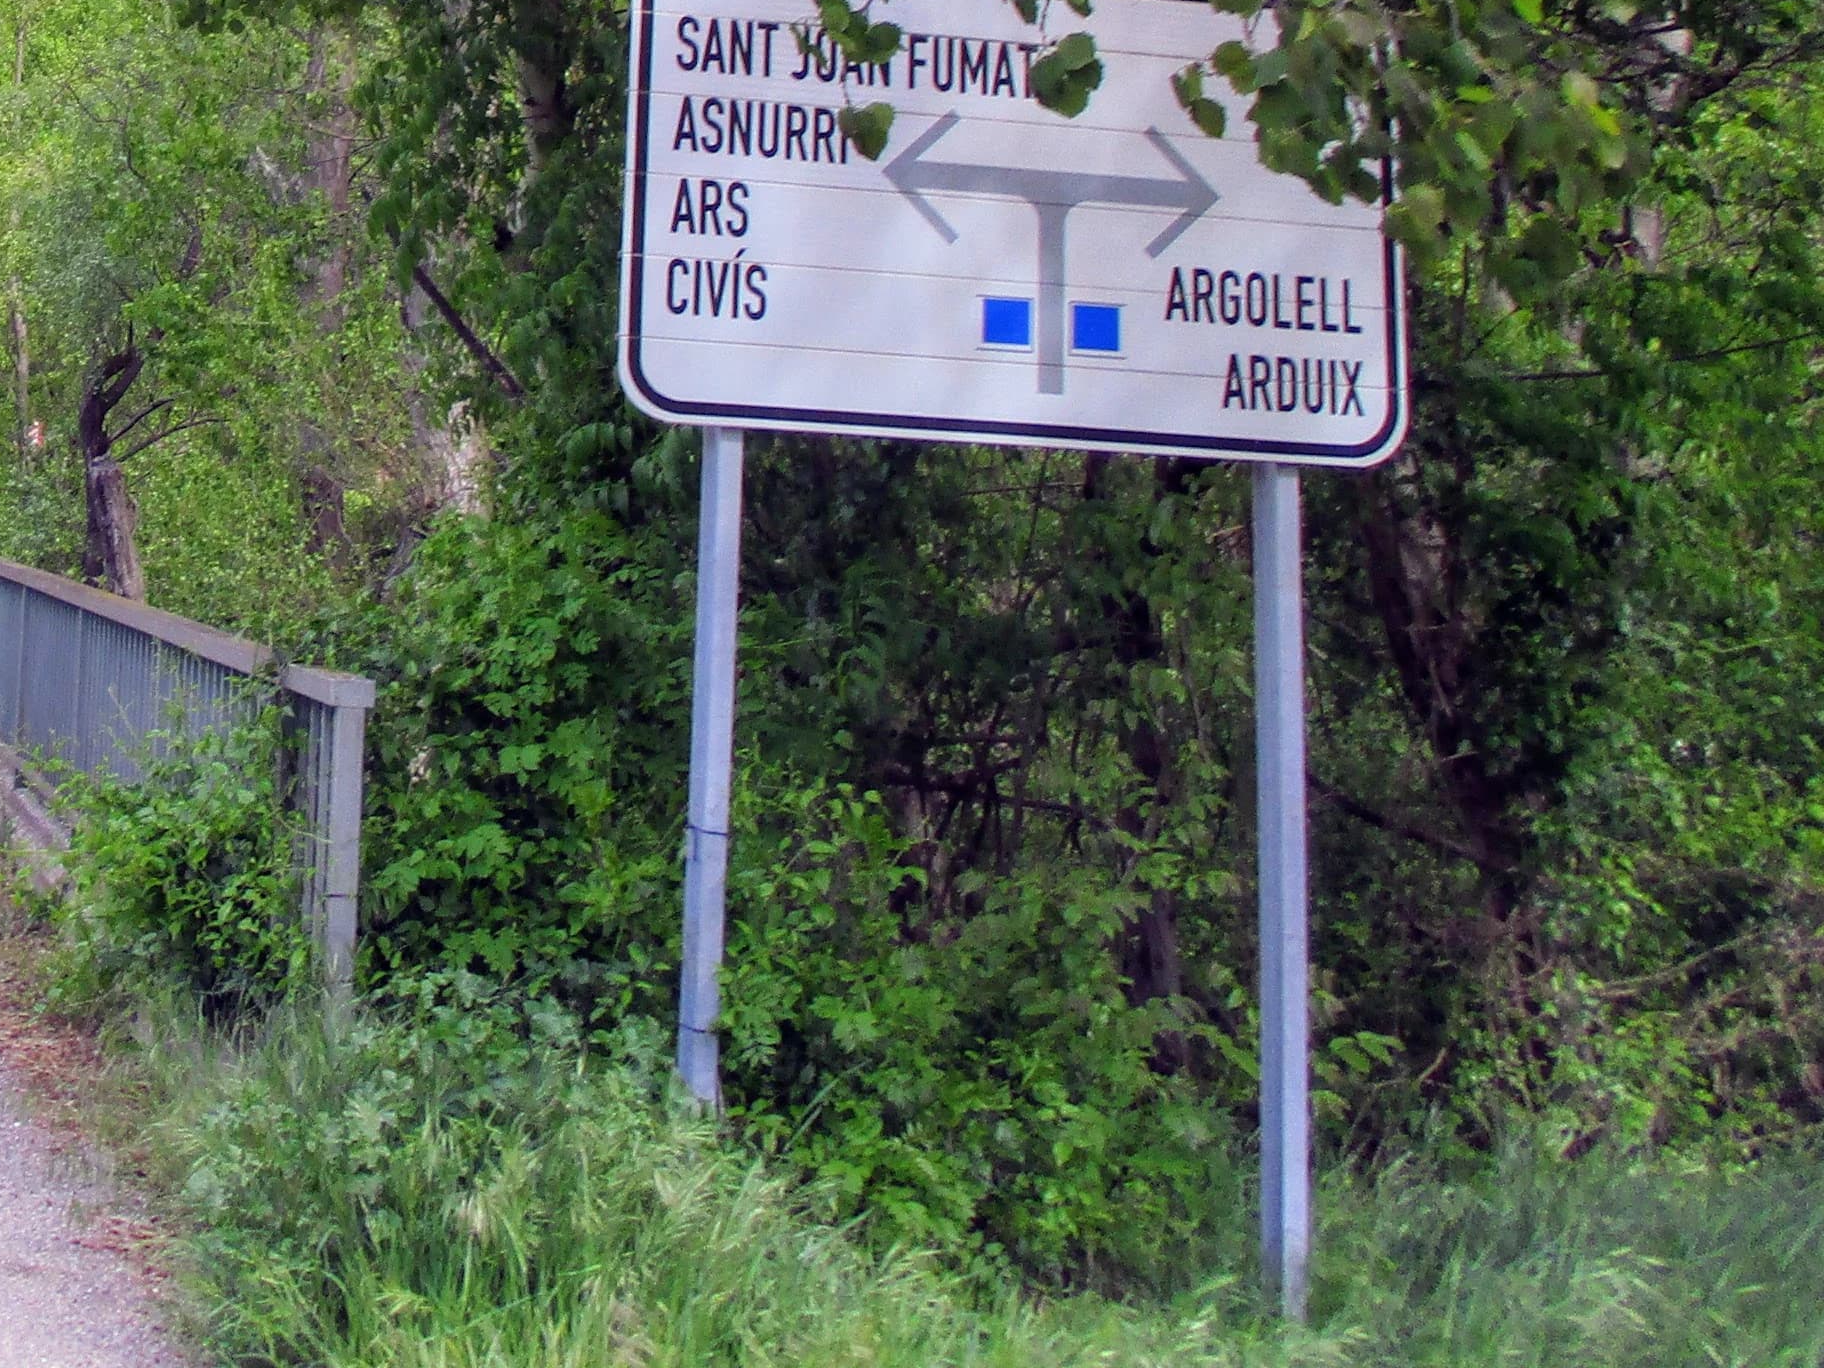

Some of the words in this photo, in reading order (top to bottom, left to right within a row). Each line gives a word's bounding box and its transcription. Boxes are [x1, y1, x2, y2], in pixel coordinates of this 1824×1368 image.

[676, 15, 779, 78] SANT
[909, 34, 1040, 99] FUMAT
[673, 96, 847, 164] ASNURRI
[671, 178, 749, 237] ARS
[666, 247, 768, 320] CIVÍS
[1165, 266, 1363, 334] ARGOLELL
[1222, 353, 1365, 417] ARDUIX
